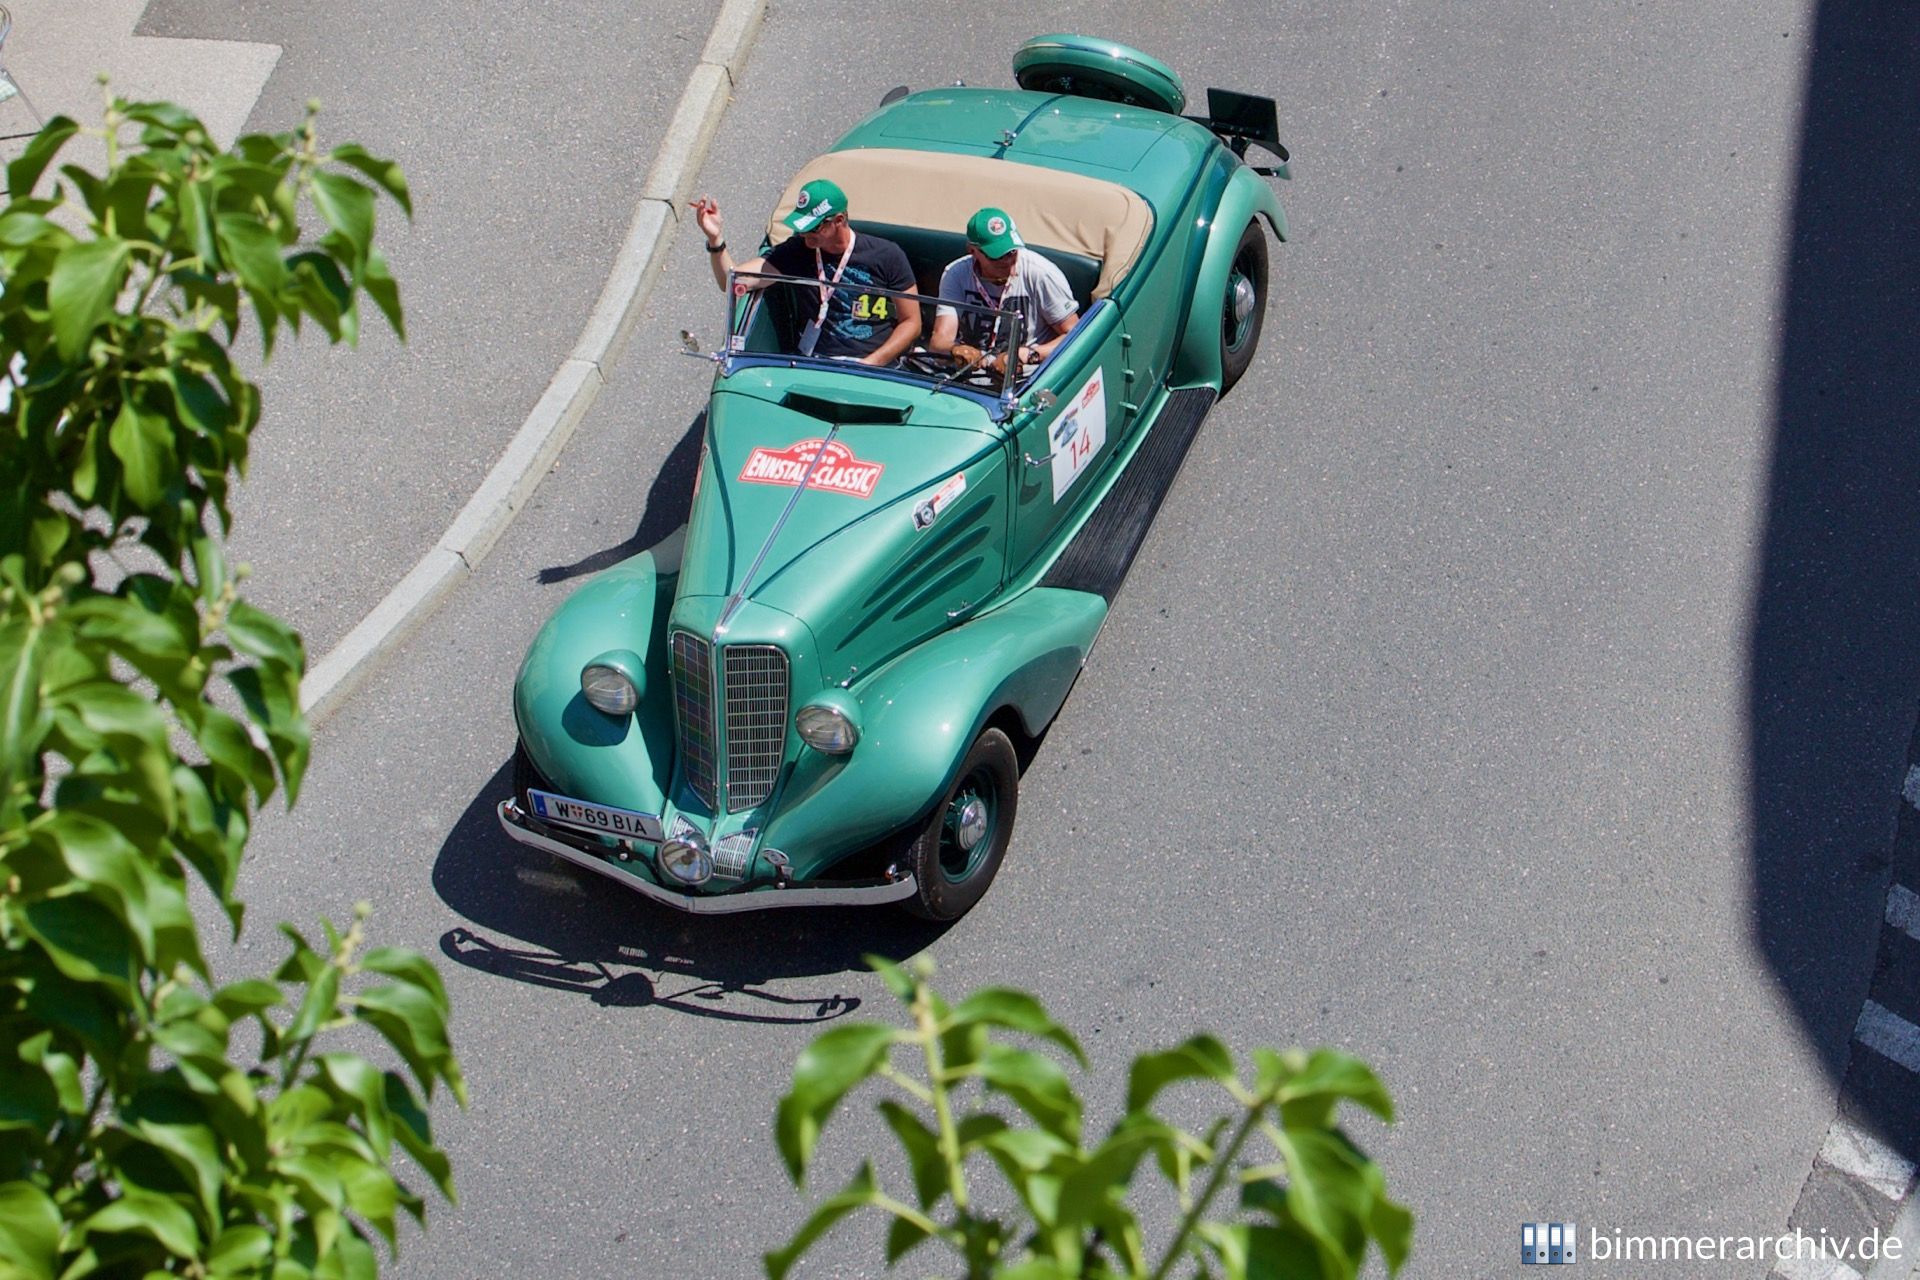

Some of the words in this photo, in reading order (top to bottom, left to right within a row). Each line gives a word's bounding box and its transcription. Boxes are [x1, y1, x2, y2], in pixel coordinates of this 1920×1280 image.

[858, 294, 888, 320] 14
[798, 452, 836, 465] 2018
[1070, 426, 1091, 469] 14
[555, 801, 569, 818] W
[584, 808, 609, 827] 69
[612, 814, 648, 836] BIA
